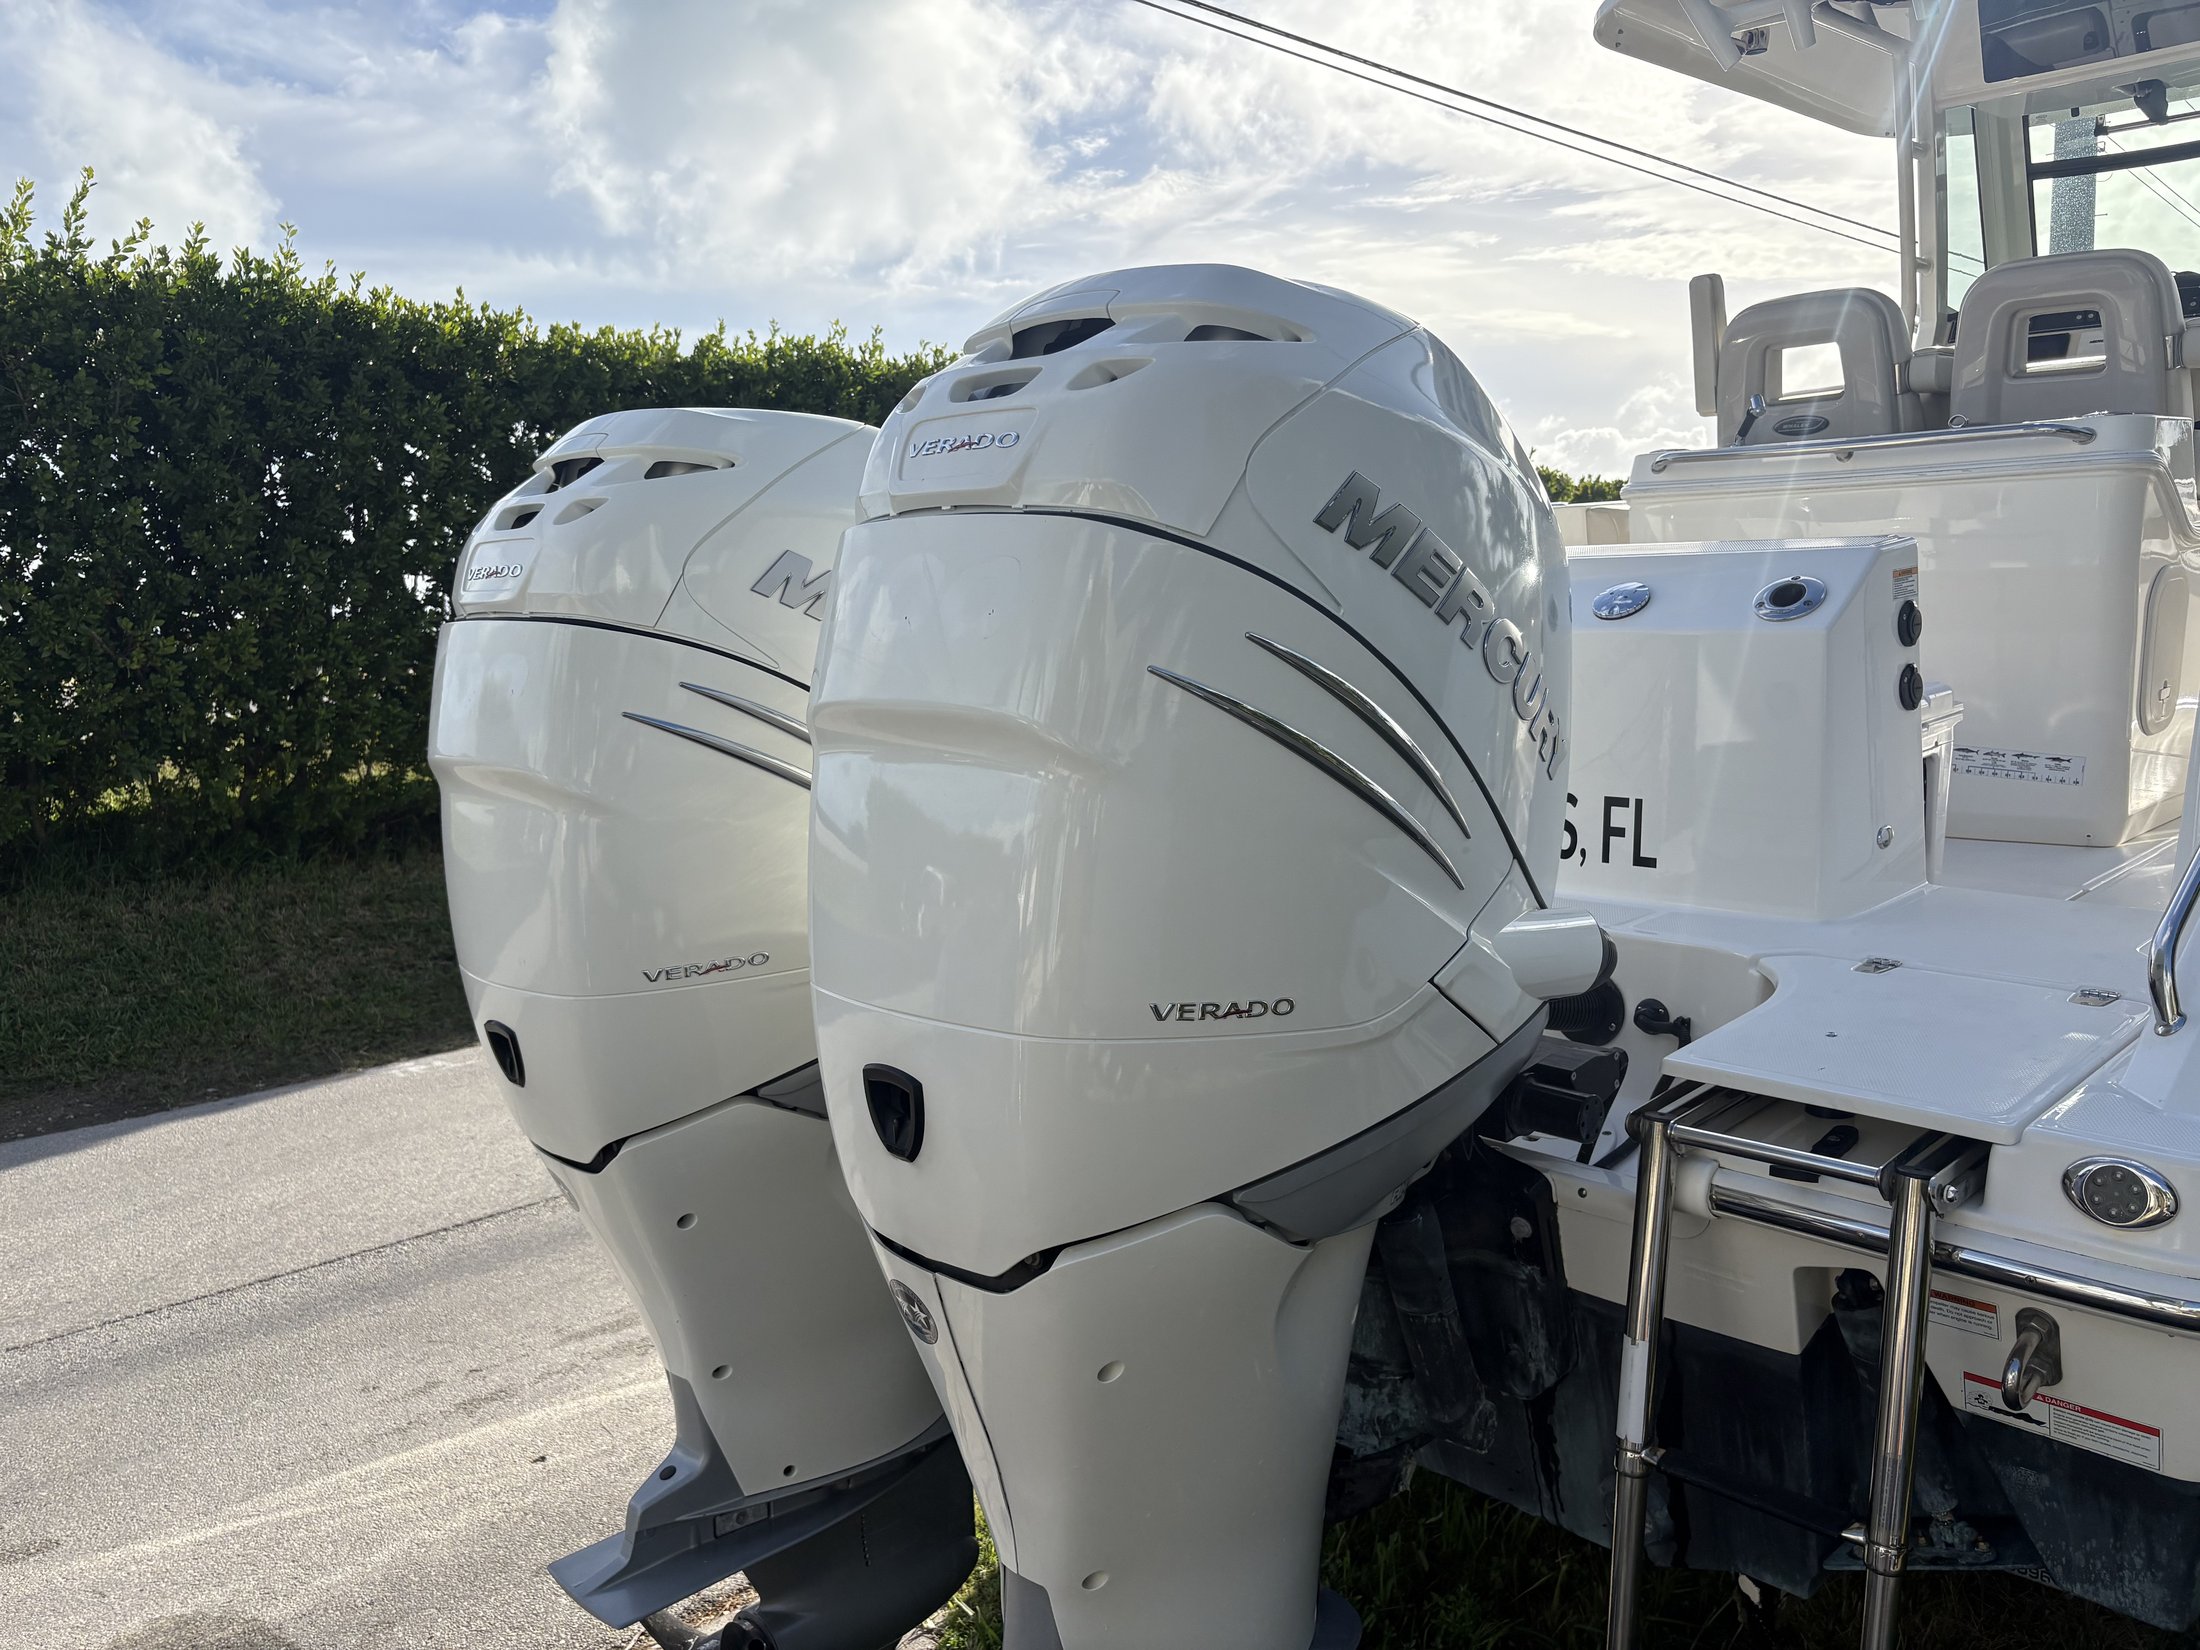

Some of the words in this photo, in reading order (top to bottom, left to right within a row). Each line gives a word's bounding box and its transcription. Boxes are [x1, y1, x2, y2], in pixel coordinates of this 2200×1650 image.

[909, 430, 1020, 459] VERADO
[468, 563, 523, 581] VERADO
[1312, 469, 1564, 781] MERCURY
[1601, 795, 1658, 869] FL
[642, 951, 770, 983] VERADO
[1149, 996, 1297, 1022] VERADO
[1934, 1291, 1976, 1307] WARNING
[2044, 1396, 2082, 1413] DANGER
